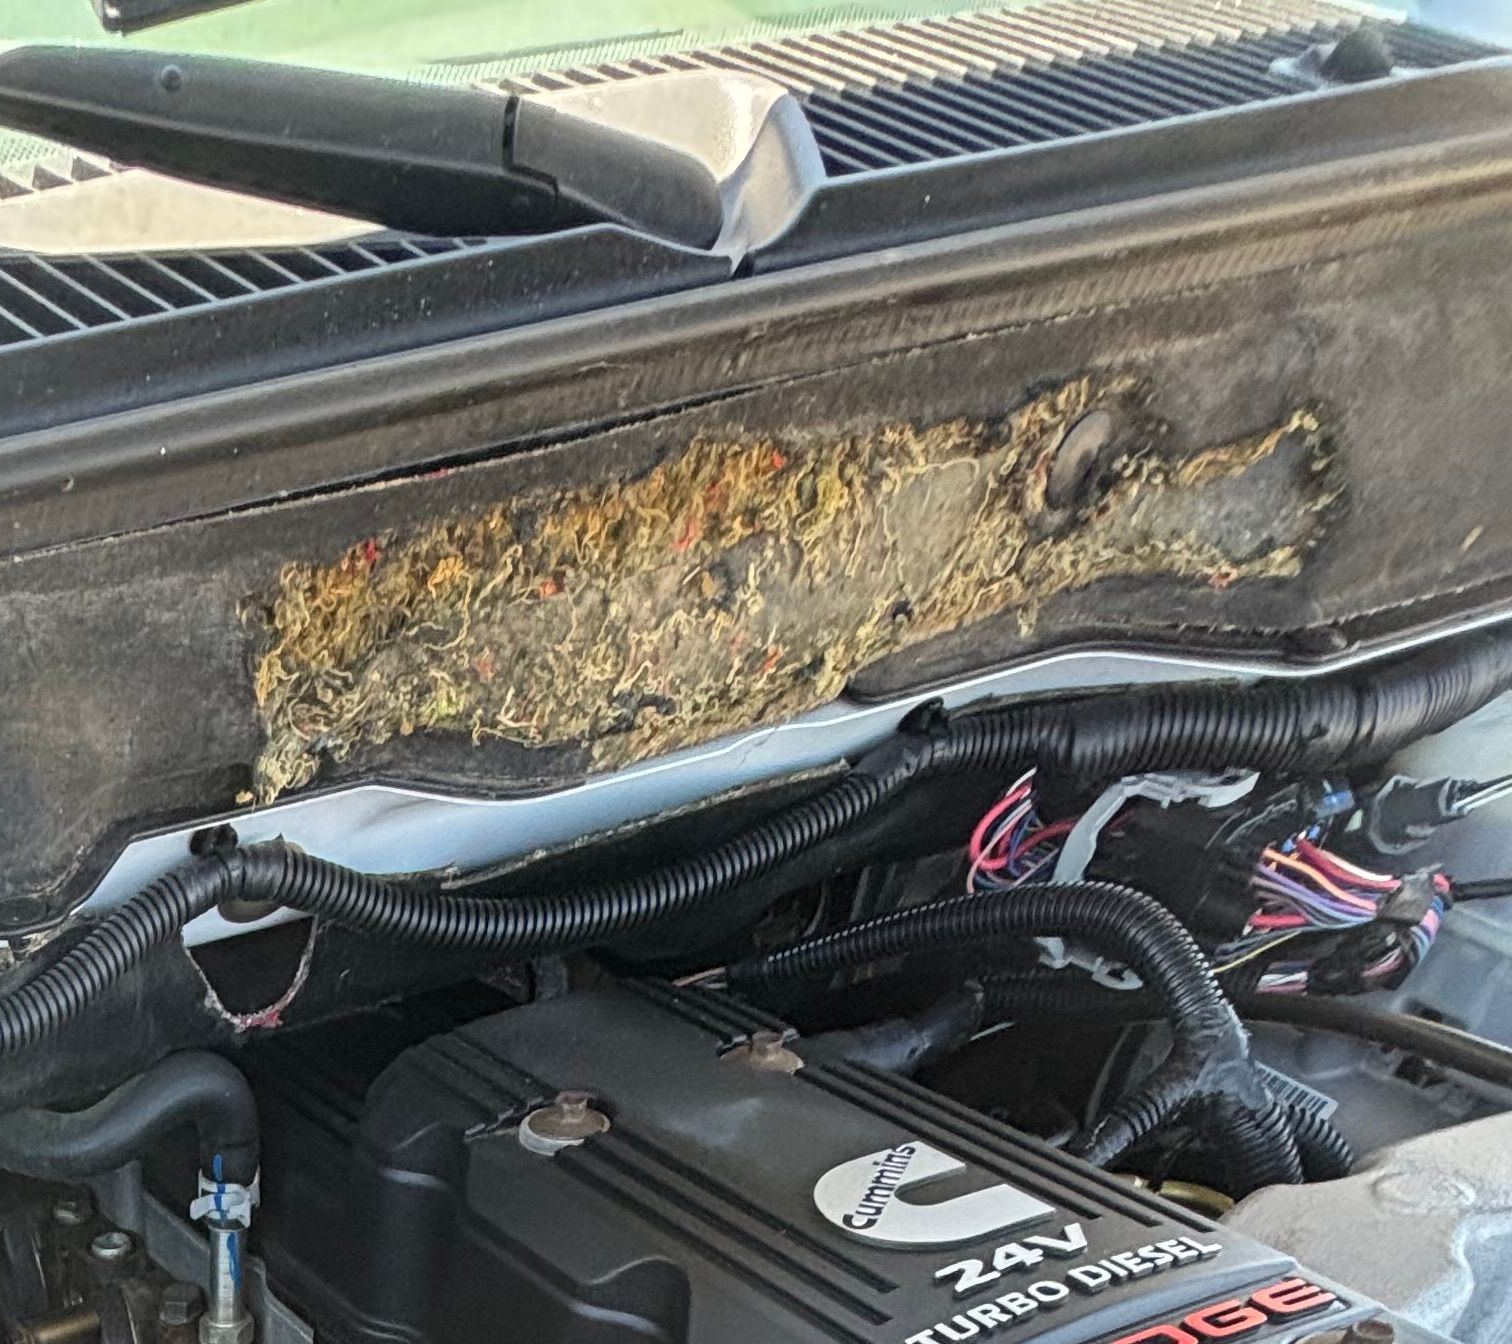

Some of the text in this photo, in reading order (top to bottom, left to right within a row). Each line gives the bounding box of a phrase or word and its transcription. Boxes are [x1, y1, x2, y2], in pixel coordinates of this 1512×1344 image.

[842, 1145, 916, 1229] Cummins
[934, 1222, 1089, 1295] 24V
[1068, 1234, 1222, 1289] DIESEL
